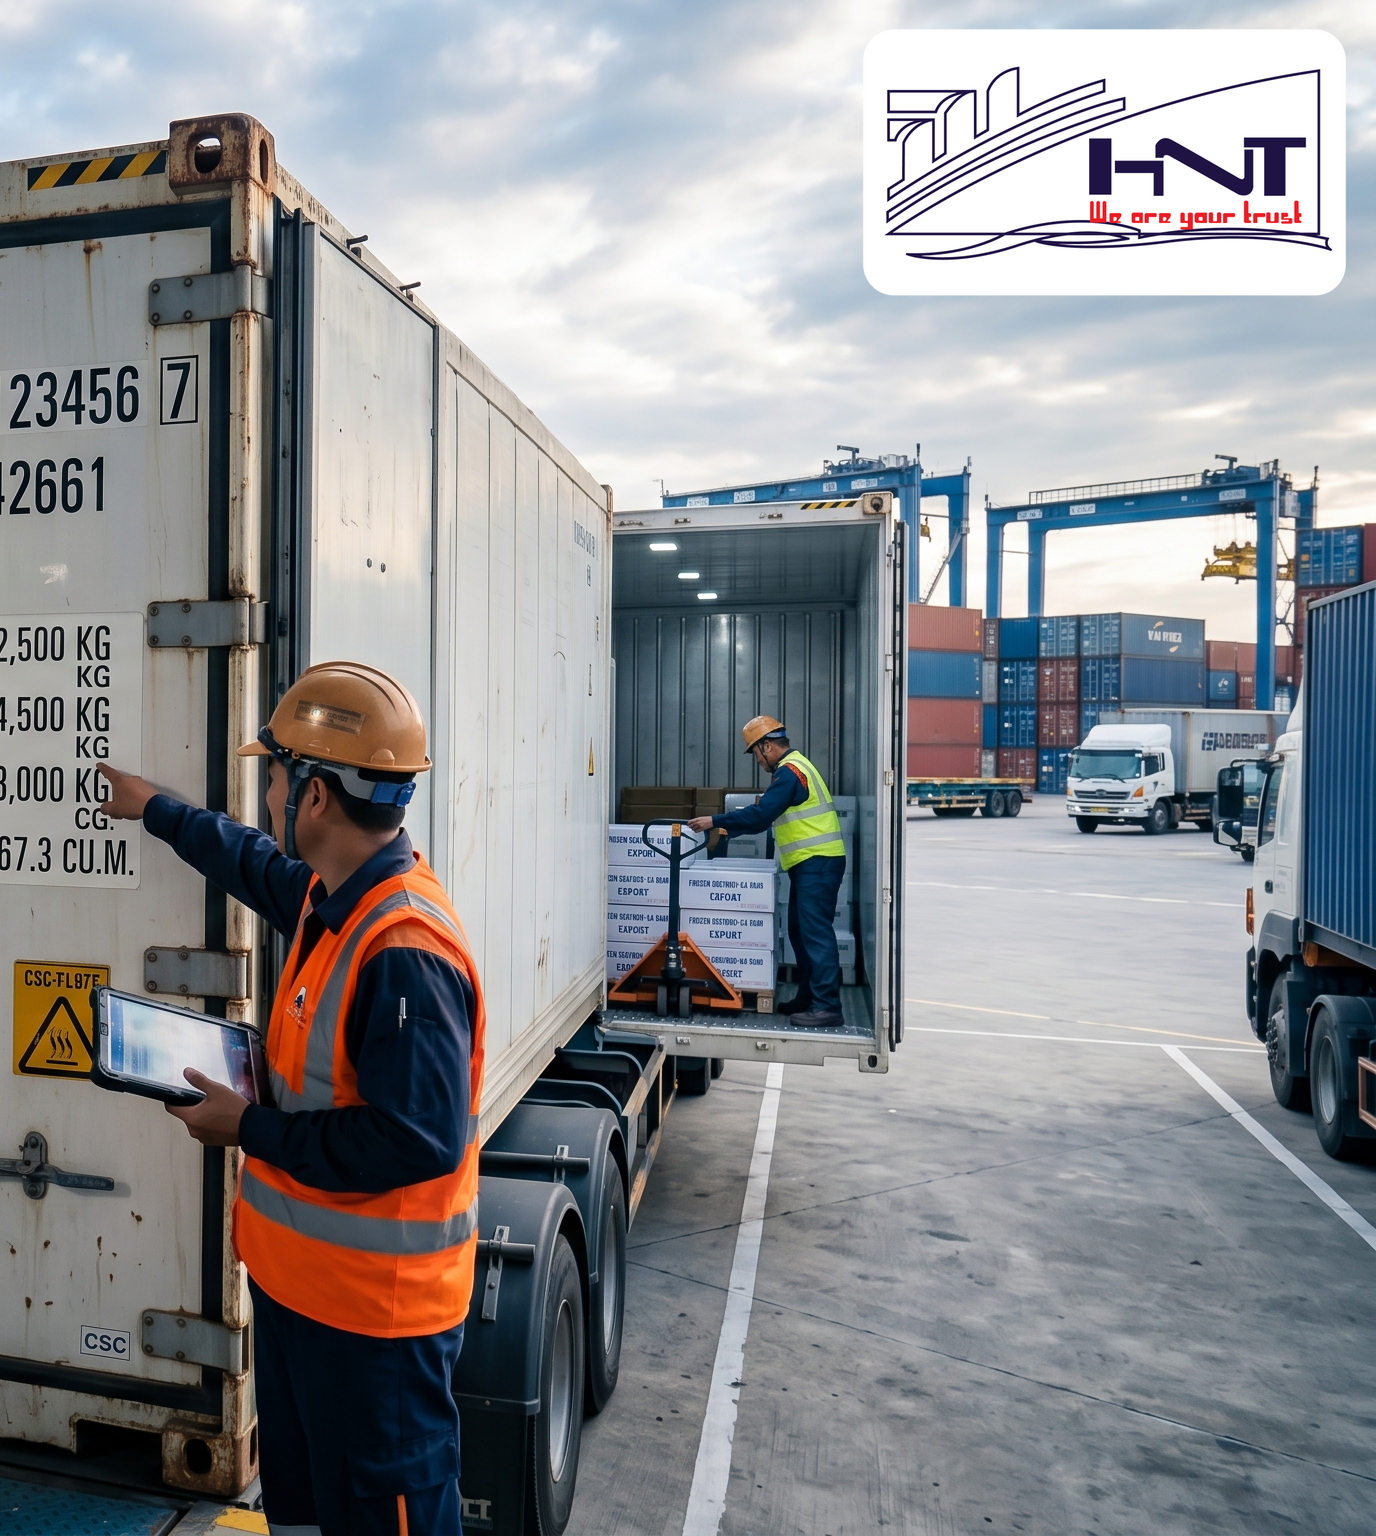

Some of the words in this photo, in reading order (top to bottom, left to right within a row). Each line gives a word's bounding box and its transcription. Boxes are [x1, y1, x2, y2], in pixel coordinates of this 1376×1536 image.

[166, 362, 191, 420] 7
[76, 625, 111, 661] KG
[76, 665, 111, 688] KG
[76, 696, 110, 732] KG
[75, 736, 110, 759] KG
[75, 767, 110, 803] KG
[62, 838, 135, 876] CU.M.
[627, 848, 657, 858] EXPORT
[84, 1332, 127, 1354] CSC
